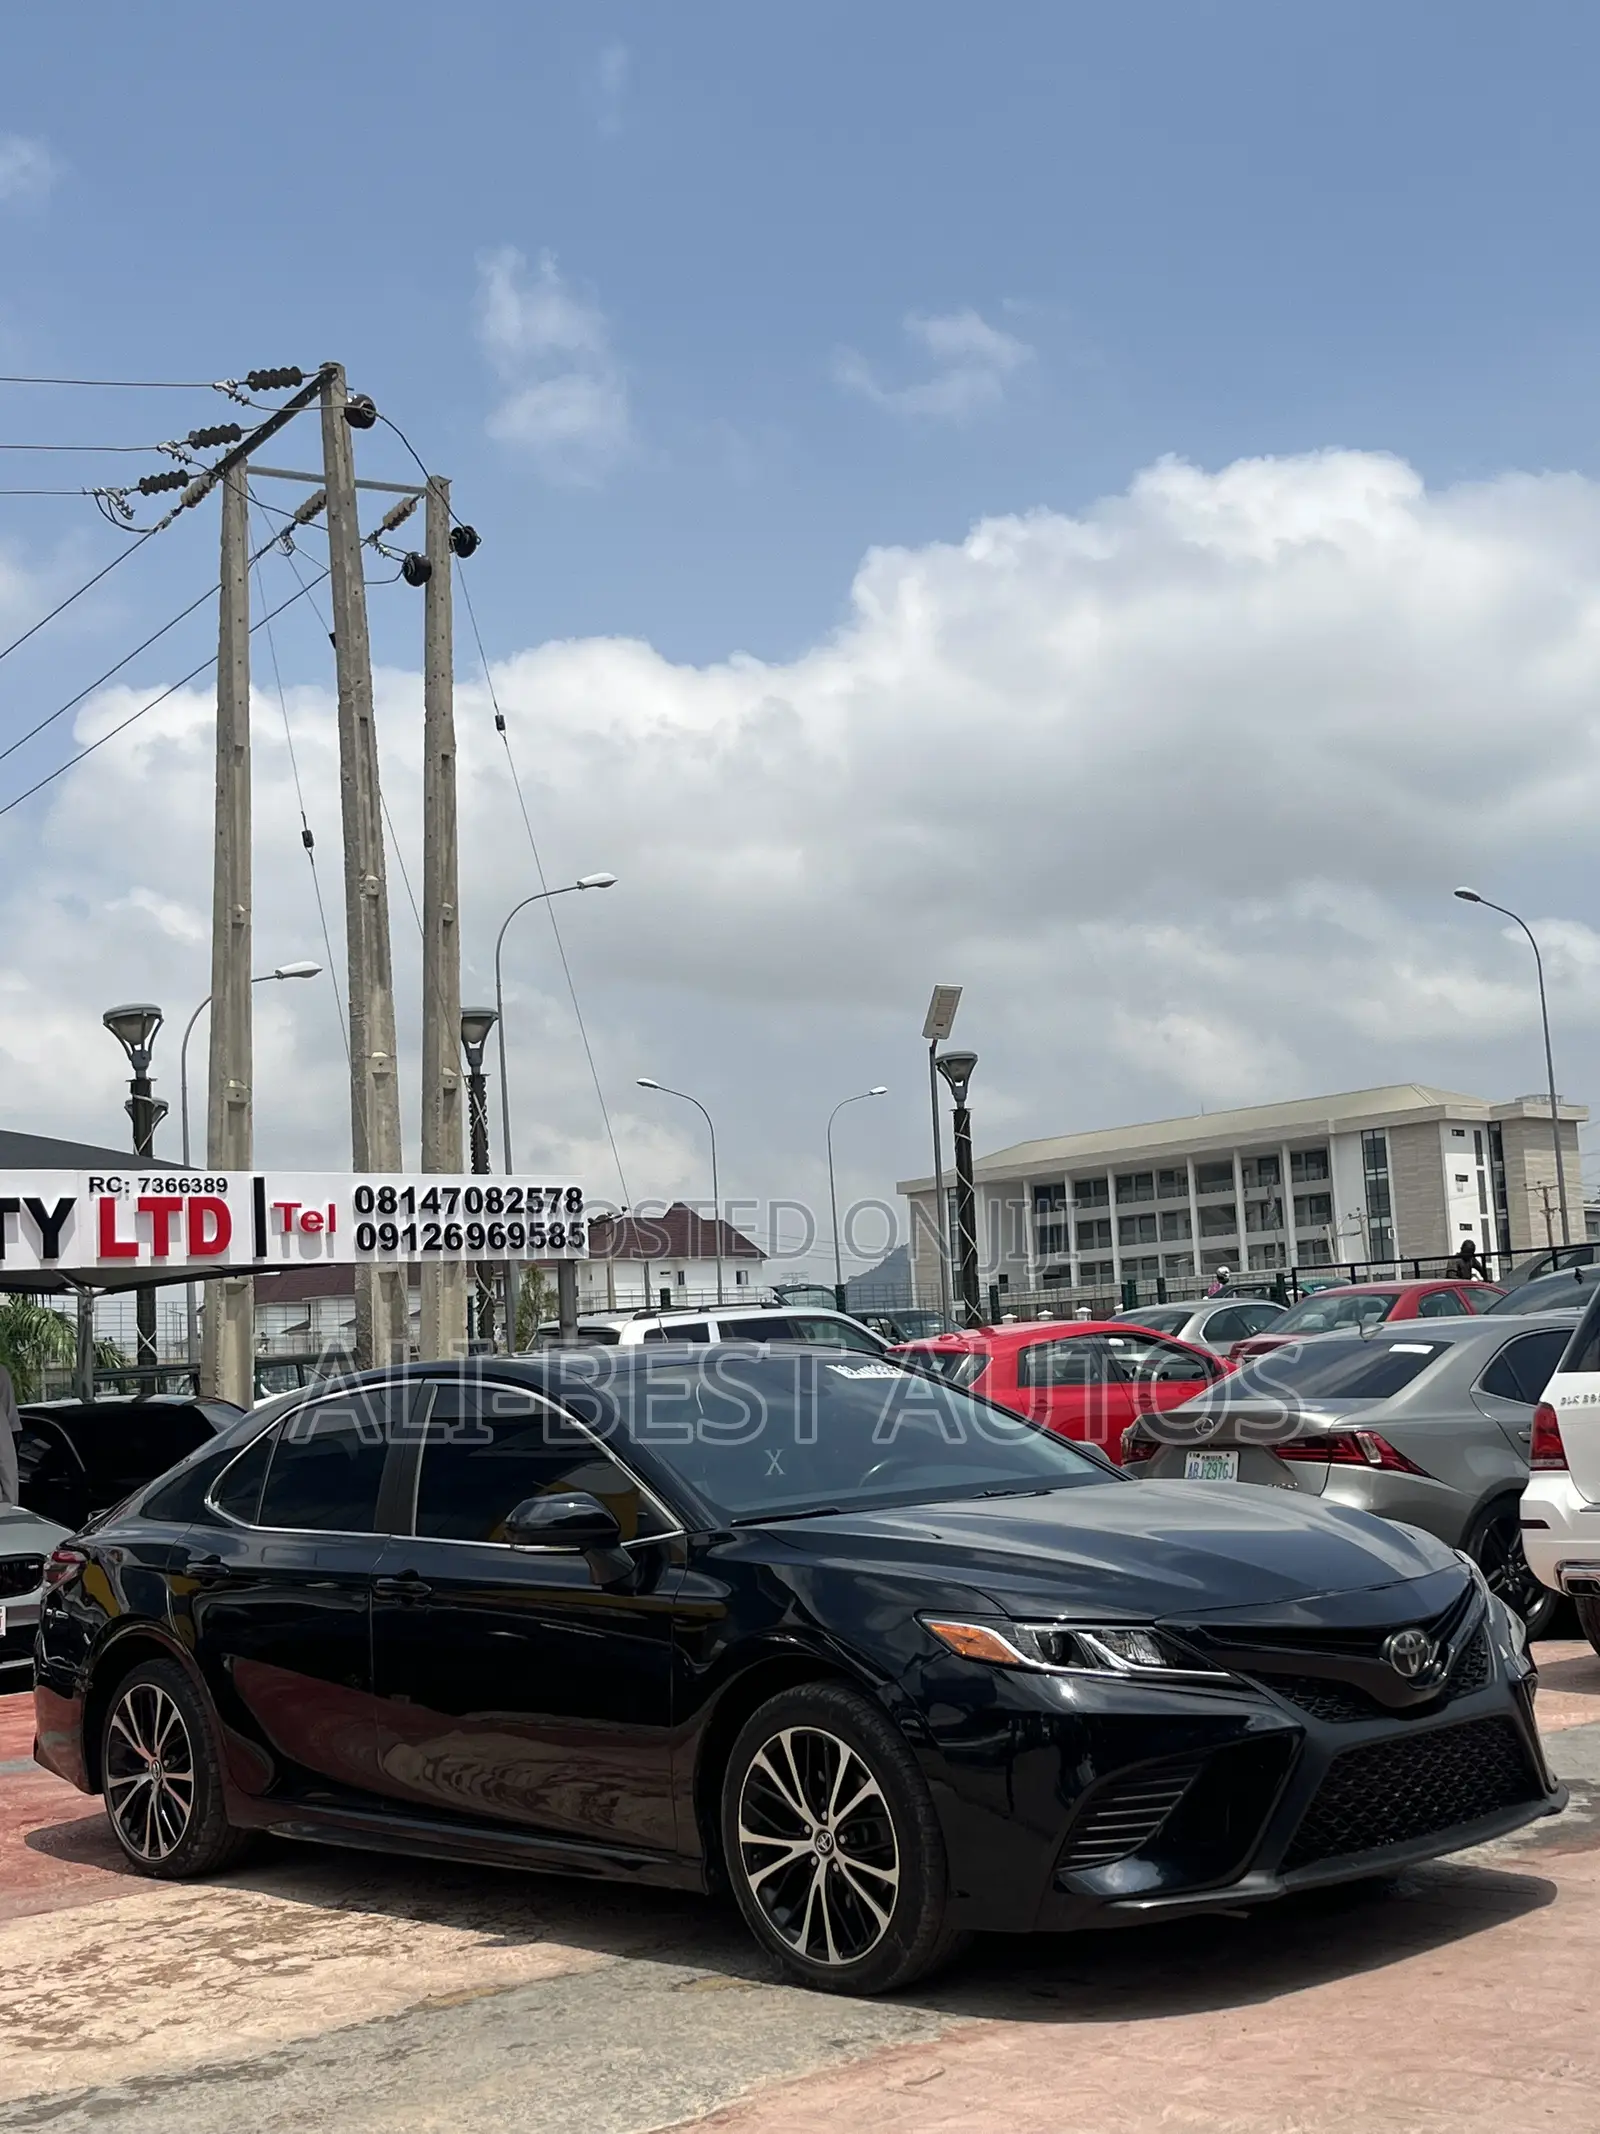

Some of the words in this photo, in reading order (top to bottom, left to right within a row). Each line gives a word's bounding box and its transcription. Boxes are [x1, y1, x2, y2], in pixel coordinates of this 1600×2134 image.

[89, 1176, 130, 1193] RC:
[138, 1176, 228, 1193] 7366389
[354, 1185, 583, 1215] 08147082578
[98, 1196, 232, 1257] LTD
[273, 1202, 336, 1233] Tel
[356, 1221, 585, 1251] 09126969585
